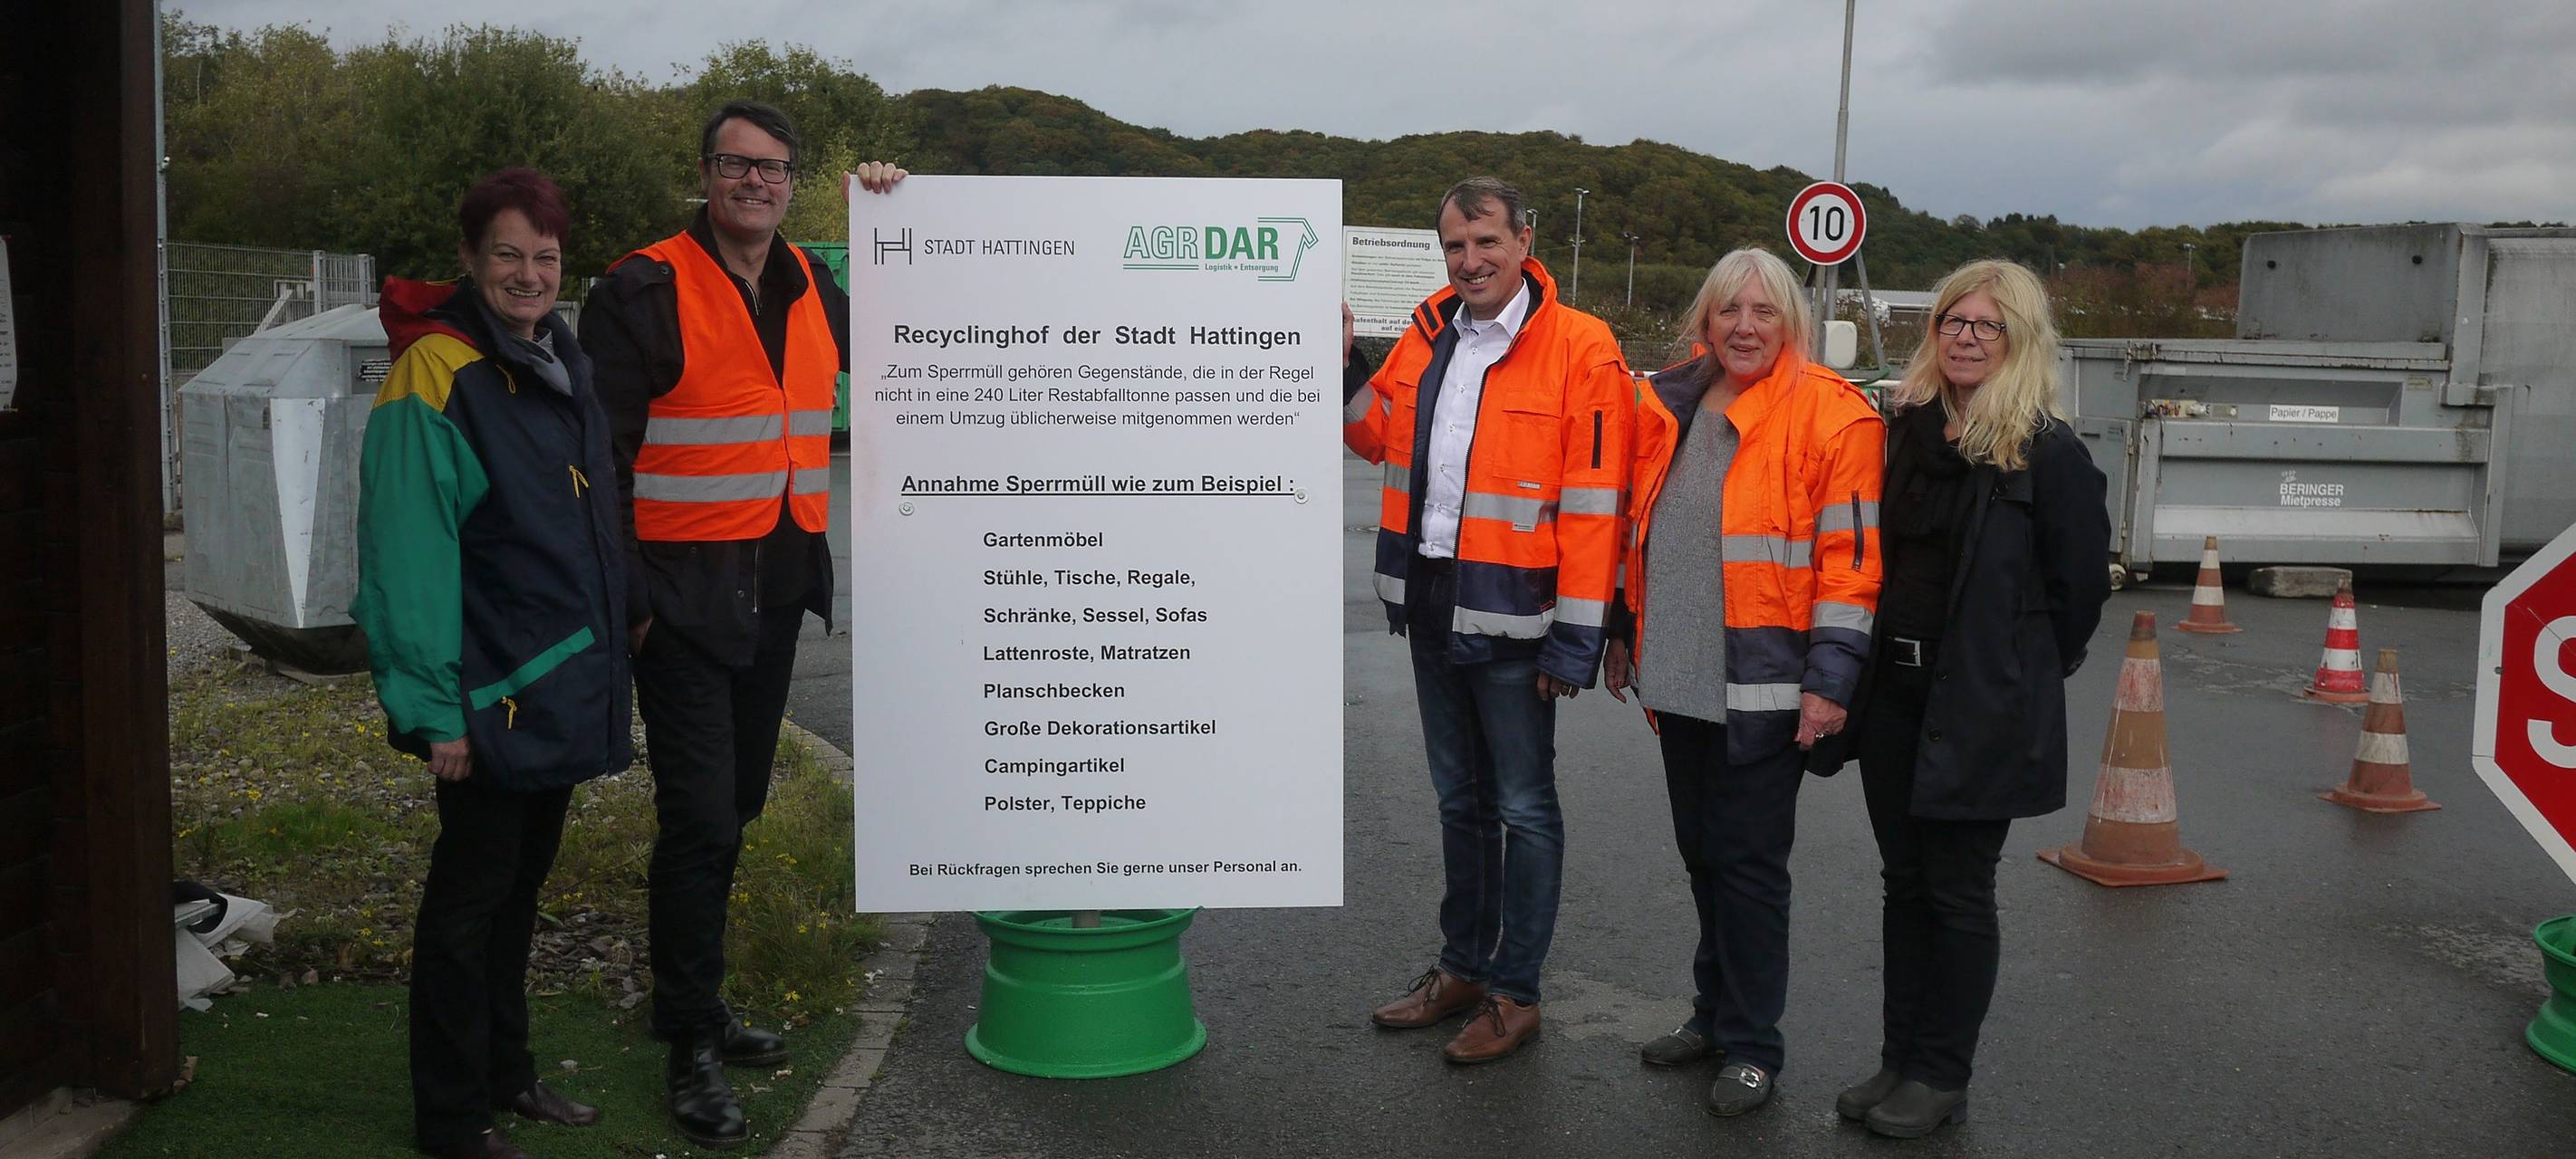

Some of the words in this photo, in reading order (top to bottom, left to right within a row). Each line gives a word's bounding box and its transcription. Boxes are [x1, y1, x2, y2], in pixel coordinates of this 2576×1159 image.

[1810, 206, 1844, 241] 10
[924, 238, 976, 255] STADT
[982, 239, 1075, 255] HATTINGEN
[1122, 225, 1199, 260] AGR
[1205, 225, 1279, 261] DAR
[1352, 236, 1430, 250] Betriebsordnung
[1205, 263, 1233, 273] Logistik
[1240, 263, 1279, 273] Entsorgung
[894, 324, 1050, 350] Recyclinghof
[1062, 325, 1101, 344] der
[1115, 325, 1177, 345] Stadt
[1190, 325, 1301, 350] Hattingen
[880, 364, 922, 380] „Zum
[927, 364, 1003, 382] Sperrmüll
[1007, 364, 1072, 382] gehören
[1078, 364, 1187, 383] Gegenstände,
[1192, 365, 1216, 379] die
[1221, 365, 1234, 379] in
[1239, 365, 1265, 379] der
[1269, 365, 1314, 383] Regel
[875, 387, 913, 402] nicht
[917, 388, 931, 402] in
[936, 388, 969, 402] eine
[974, 388, 1004, 402] 240
[1009, 388, 1044, 402] Liter
[1048, 388, 1170, 402] Restabfalltonne
[1175, 391, 1231, 406] passen
[1235, 388, 1264, 403] und
[1269, 388, 1293, 403] die
[1297, 388, 1321, 403] bei
[896, 410, 944, 426] einem
[949, 410, 1005, 428] Umzug
[1010, 410, 1117, 426] üblicherweise
[1122, 411, 1232, 429] mitgenommen
[1236, 411, 1300, 426] werden“
[2271, 407, 2300, 418] Papier
[2308, 408, 2338, 420] Pappe
[899, 474, 1001, 493] Annahme
[1005, 474, 1106, 498] Sperrmüll
[1110, 474, 1147, 492] wie
[1152, 479, 1195, 492] zum
[1201, 474, 1283, 498] Beispiel
[2279, 484, 2344, 496] BERINGER
[2281, 495, 2341, 508] Mietpresse
[983, 532, 1103, 548] Gartenmöbel
[983, 570, 1048, 588] Stühle,
[1053, 570, 1121, 588] Tische,
[1128, 569, 1196, 589] Regale,
[984, 607, 1076, 626] Schränke,
[1082, 607, 1149, 626] Sessel,
[1155, 607, 1207, 623] Sofas
[984, 646, 1094, 664] Lattenroste,
[1101, 645, 1190, 660] Matratzen
[984, 683, 1125, 699] Planschbecken
[984, 720, 1042, 736] Große
[1047, 719, 1216, 736] Dekorationsartikel
[985, 757, 1125, 778] Campingartikel
[985, 796, 1055, 813] Polster,
[1061, 794, 1147, 814] Teppiche
[909, 863, 933, 876] Bei
[937, 863, 1021, 878] Rückfragen
[1024, 862, 1092, 877] sprechen
[1096, 861, 1120, 875] Sie
[1123, 864, 1165, 876] gerne
[1168, 863, 1210, 874] unser
[1214, 859, 1276, 873] Personal
[1280, 862, 1302, 872] an.
